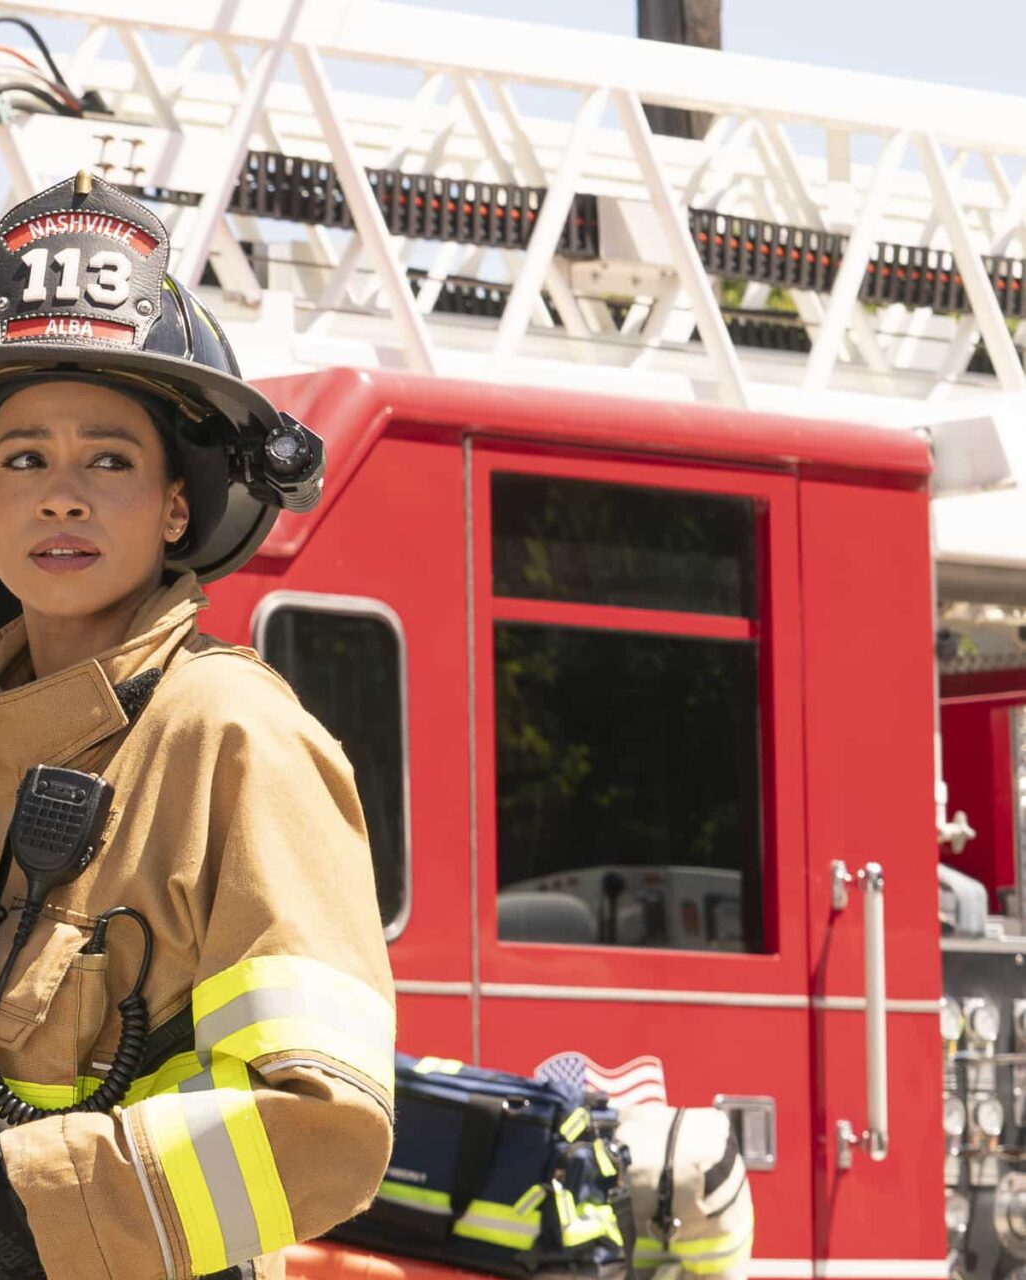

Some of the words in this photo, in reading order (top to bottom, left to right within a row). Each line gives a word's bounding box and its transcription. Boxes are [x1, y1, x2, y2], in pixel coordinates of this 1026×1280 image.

[27, 215, 139, 244] NASHVILLE
[21, 247, 133, 305] 113
[45, 319, 94, 337] ALBA
